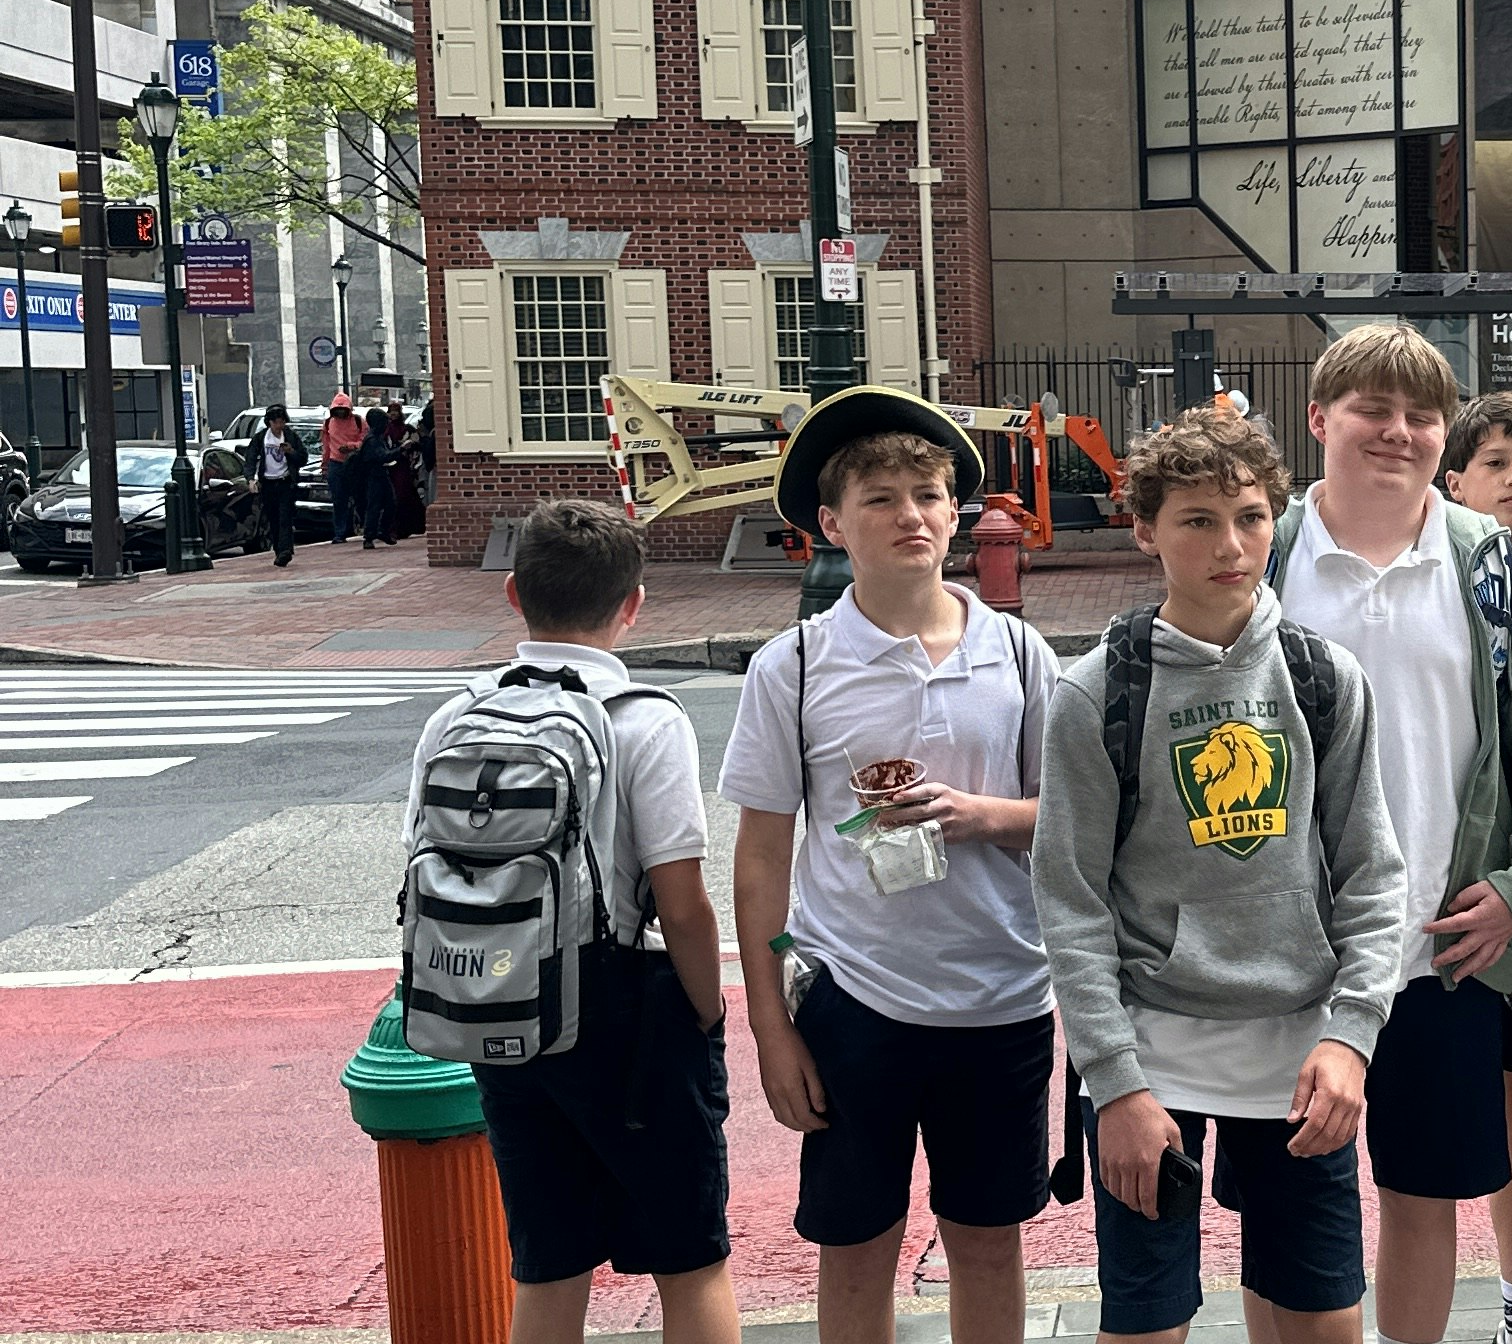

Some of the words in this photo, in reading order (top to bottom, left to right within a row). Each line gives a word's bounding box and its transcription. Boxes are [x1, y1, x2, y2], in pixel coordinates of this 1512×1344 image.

[1223, 15, 1252, 36] these
[1299, 10, 1314, 28] to
[1315, 5, 1329, 27] be
[1199, 47, 1221, 68] all
[1220, 55, 1245, 66] men
[1247, 53, 1265, 63] are
[1268, 38, 1314, 62] creted
[1313, 33, 1351, 65] equal,
[1353, 31, 1392, 53] that
[179, 53, 213, 77] 618
[181, 78, 211, 87] Garage
[1164, 90, 1181, 100] are
[1238, 72, 1254, 105] by
[1340, 61, 1375, 85] with
[1234, 102, 1283, 134] Rights,
[1317, 103, 1358, 127] among
[1360, 90, 1393, 112] these
[1236, 159, 1281, 206] Life,
[1295, 154, 1368, 204] Liberty
[828, 277, 851, 286] TIME
[829, 267, 849, 276] ANY
[26, 295, 46, 315] XIT
[47, 297, 73, 316] ONLY
[1491, 374, 1507, 383] this
[697, 391, 727, 402] JLG
[729, 393, 763, 405] LIFT
[623, 439, 662, 449] T350
[1168, 700, 1235, 730] SAINT
[1243, 700, 1279, 718] LEO
[1204, 812, 1275, 839] LIONS
